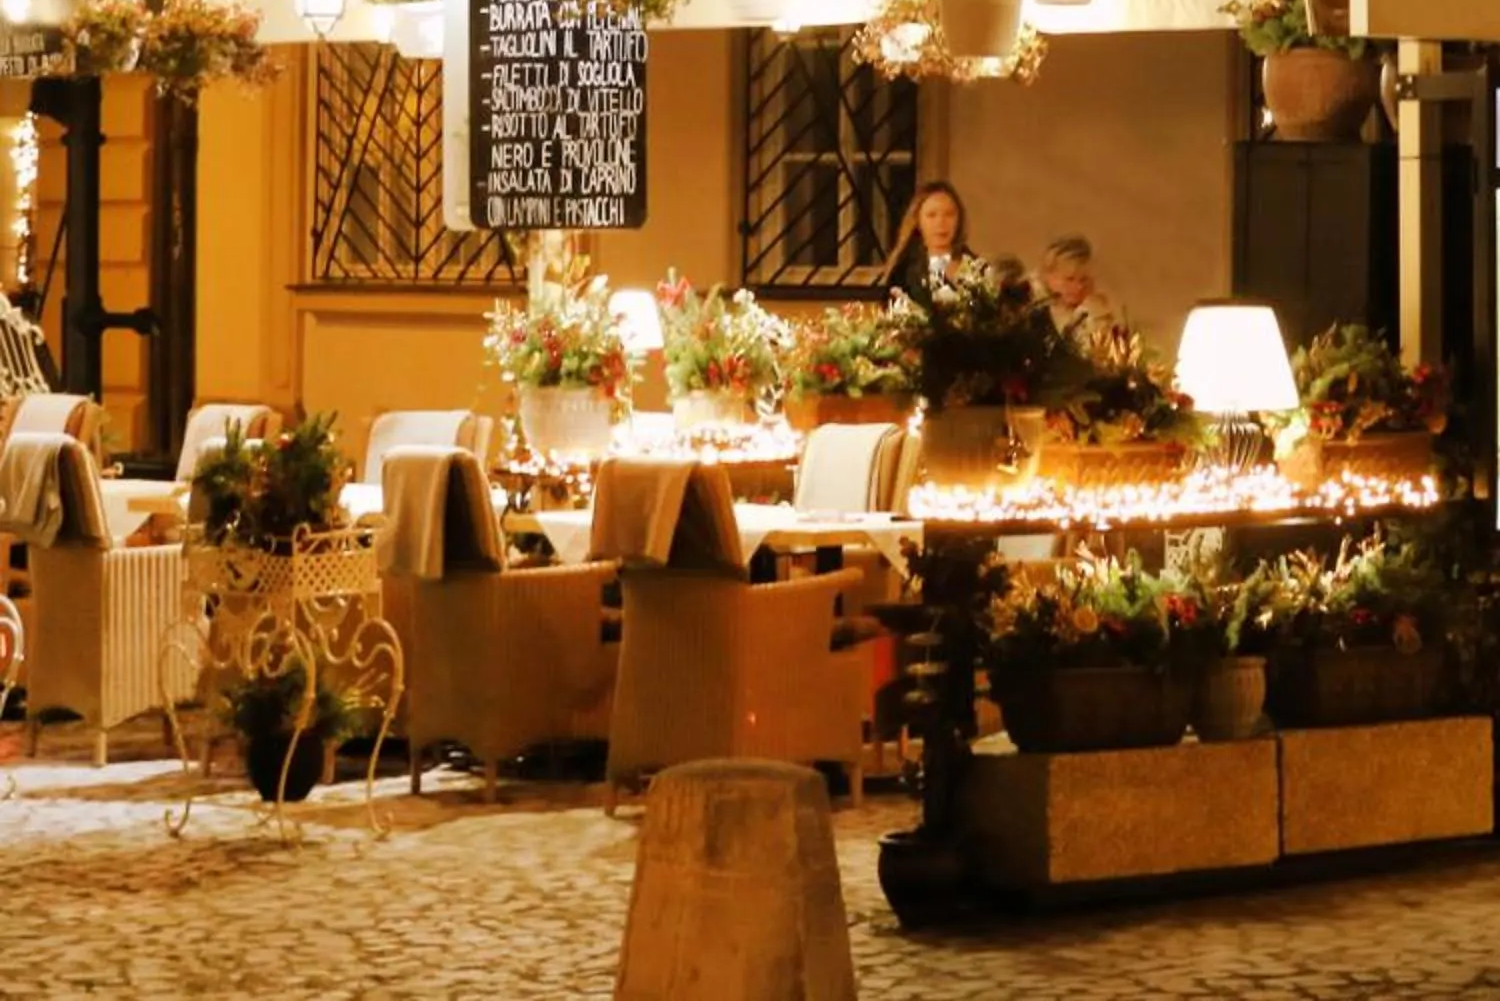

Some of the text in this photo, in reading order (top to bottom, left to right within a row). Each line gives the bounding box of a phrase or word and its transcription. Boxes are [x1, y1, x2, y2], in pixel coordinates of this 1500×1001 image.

[489, 0, 551, 31] BURRATA
[489, 30, 556, 58] TAGLIOLINI
[586, 30, 648, 63] TARTUFO
[493, 61, 636, 87] FILETTI DI SOGLIOLA
[588, 87, 644, 115] VITELLO
[491, 111, 636, 140] RISOTTO AL TARTUFO
[491, 139, 636, 168] NERO E PROVOLONE
[488, 163, 636, 194] INSALATA DI CAPRINO
[565, 197, 624, 226] PISTACCHI
